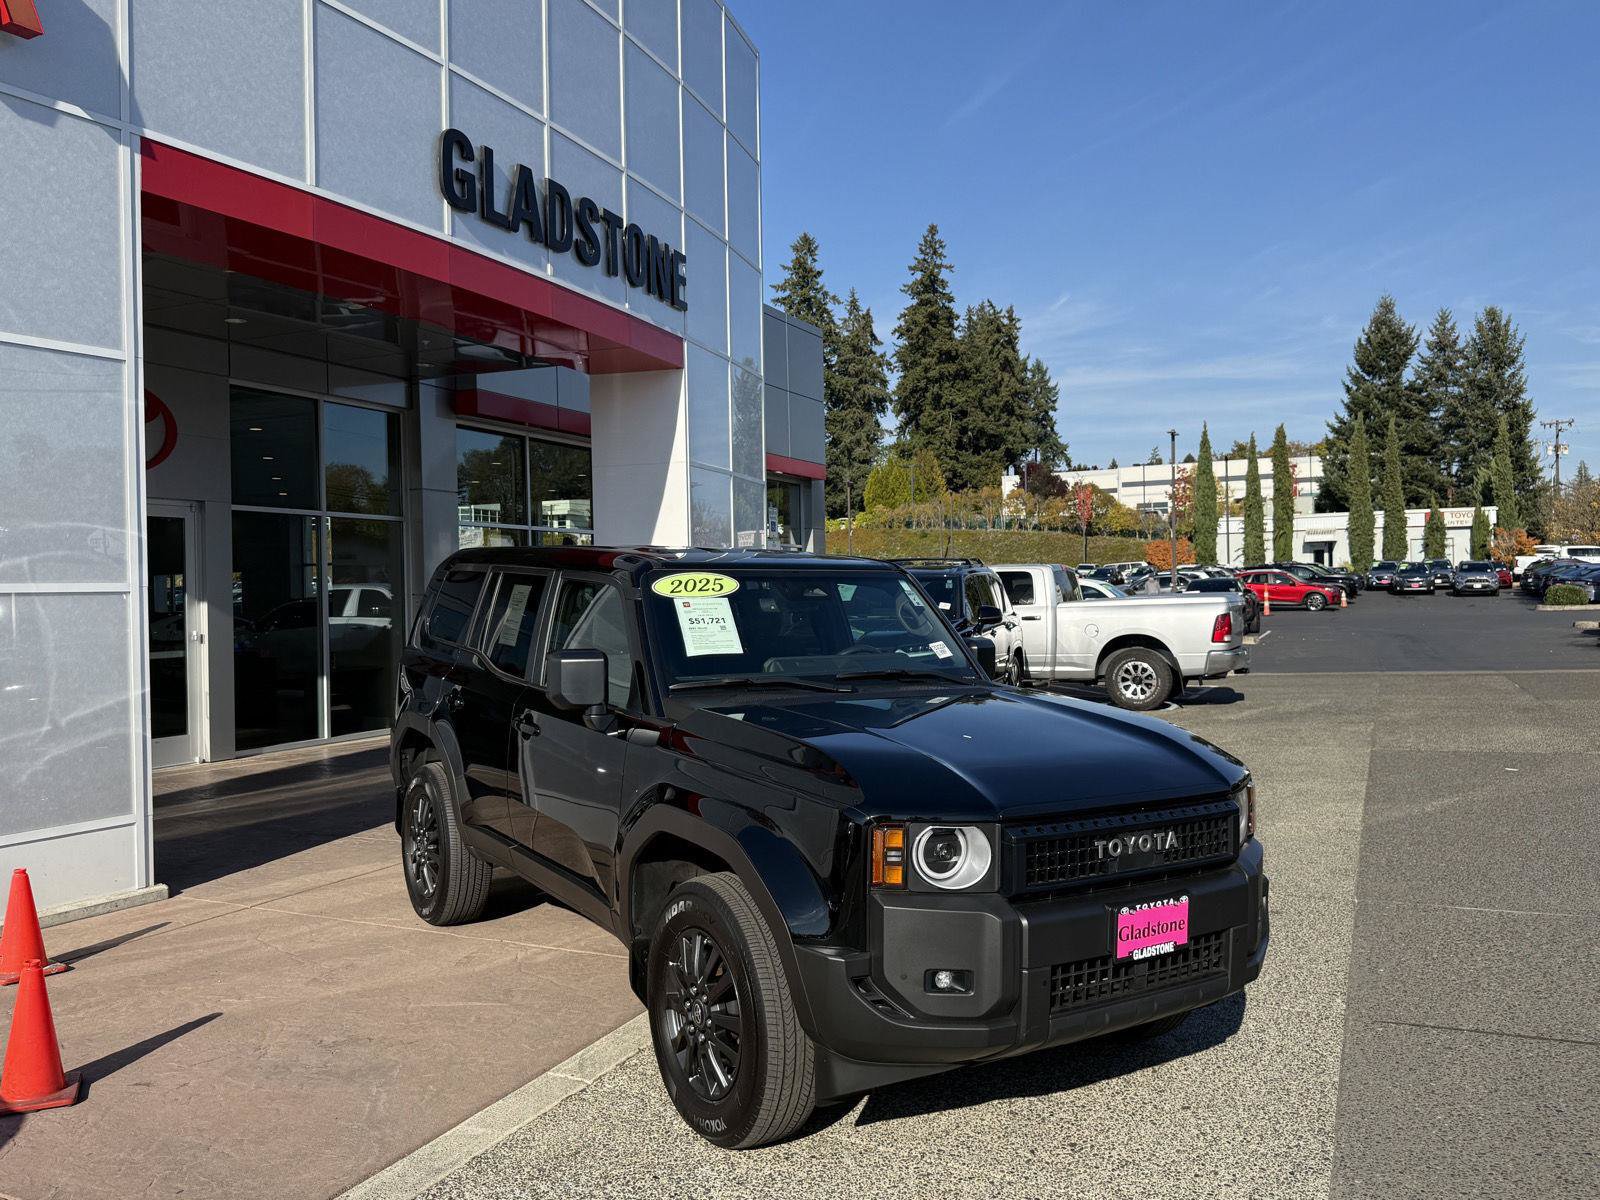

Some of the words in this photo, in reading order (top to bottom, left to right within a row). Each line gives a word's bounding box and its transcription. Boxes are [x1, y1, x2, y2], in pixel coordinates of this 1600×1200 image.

[440, 128, 688, 312] GLADSTONE
[670, 578, 724, 593] 2025
[688, 617, 727, 625] $51,721
[1094, 831, 1179, 859] TOYOTA
[1136, 899, 1174, 911] TOYOTA
[1118, 919, 1186, 942] Gladstone
[1133, 942, 1175, 960] GLADSTONE
